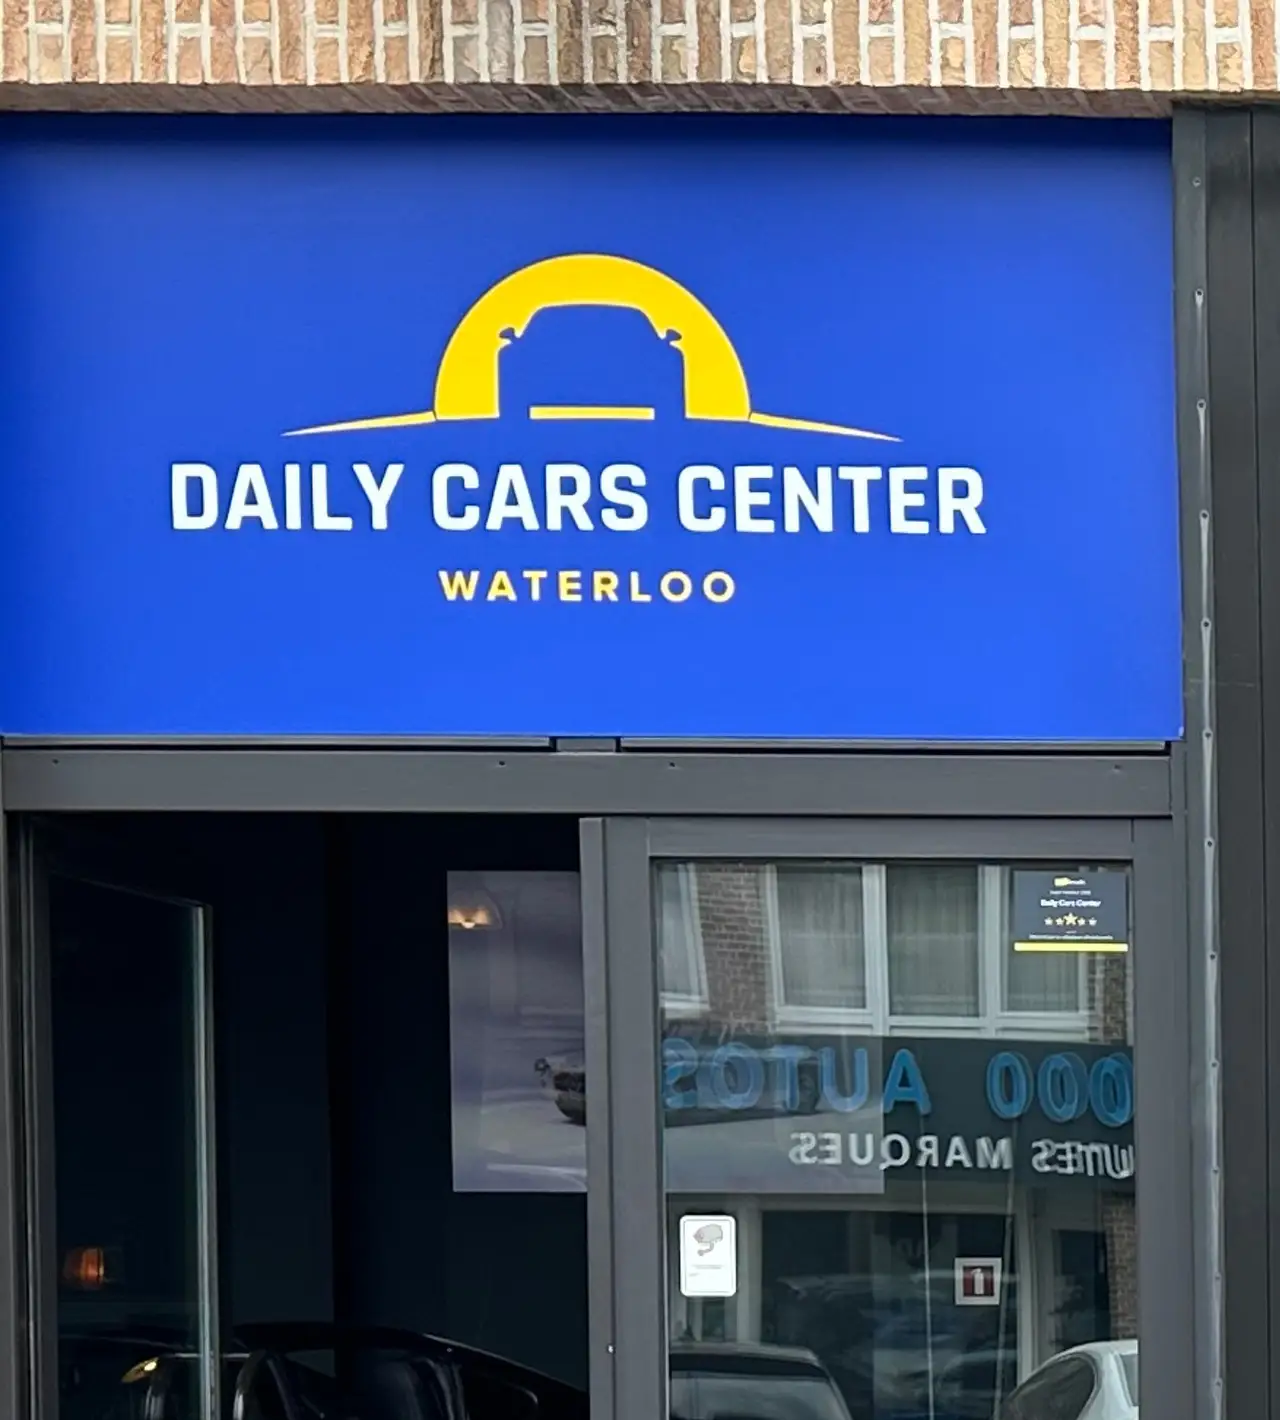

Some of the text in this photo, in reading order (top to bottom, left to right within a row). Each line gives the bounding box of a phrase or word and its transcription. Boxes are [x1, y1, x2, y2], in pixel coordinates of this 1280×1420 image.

[171, 463, 987, 535] DAILY CARS CENTER
[438, 569, 736, 604] WATERLOO
